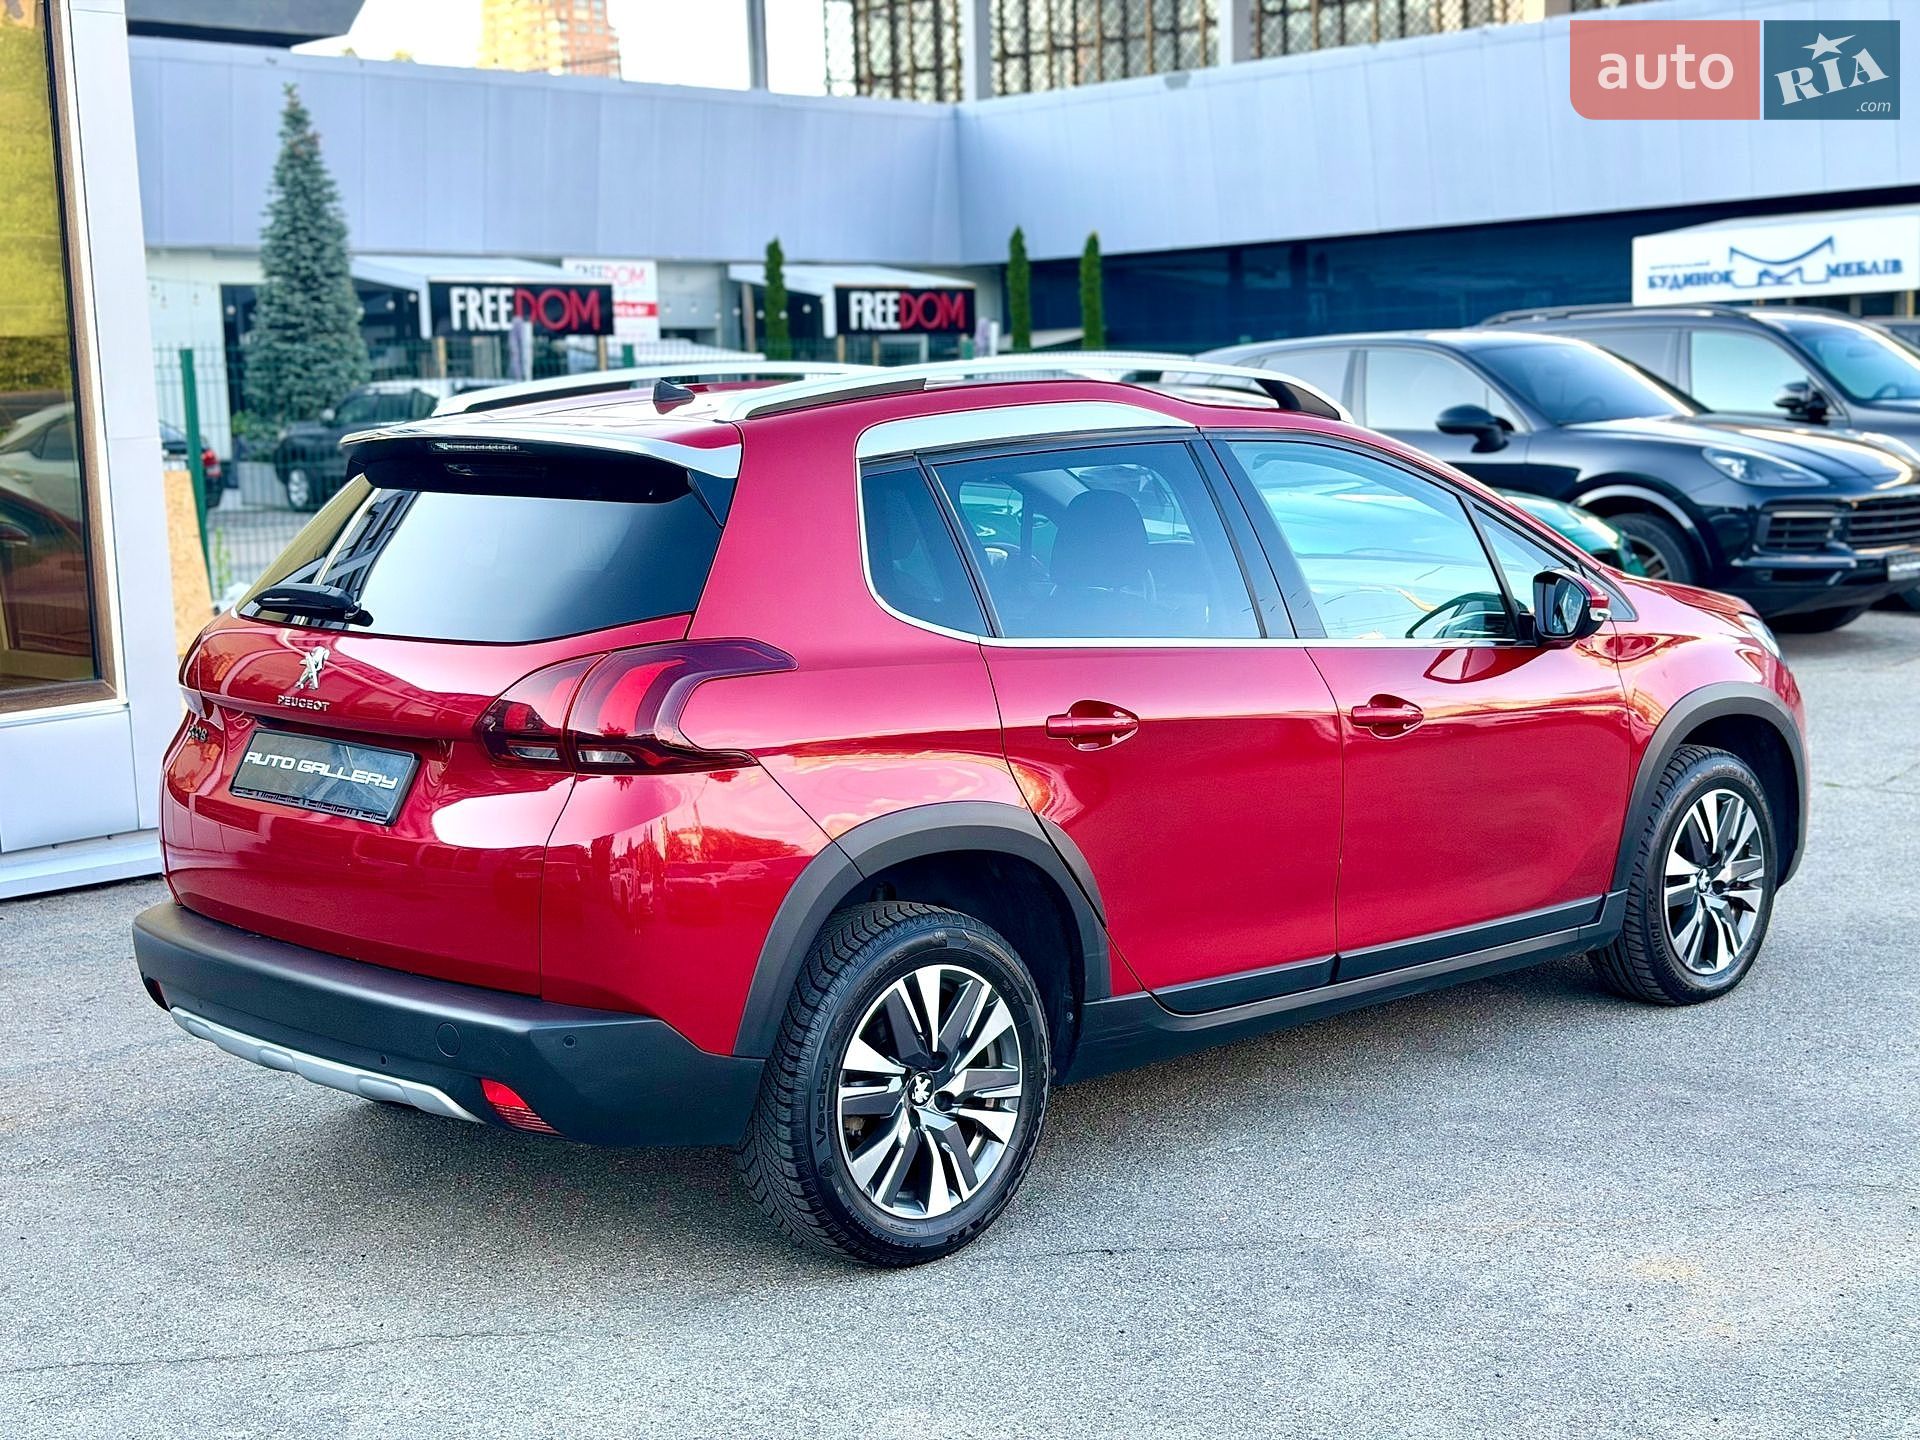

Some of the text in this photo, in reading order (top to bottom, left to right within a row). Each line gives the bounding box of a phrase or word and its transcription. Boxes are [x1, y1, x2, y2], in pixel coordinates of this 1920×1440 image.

[450, 286, 601, 331] FREEDOM
[849, 290, 965, 331] FREEDOM
[277, 695, 331, 712] PEUGEOT
[243, 751, 399, 790] AUTO GALLERY
